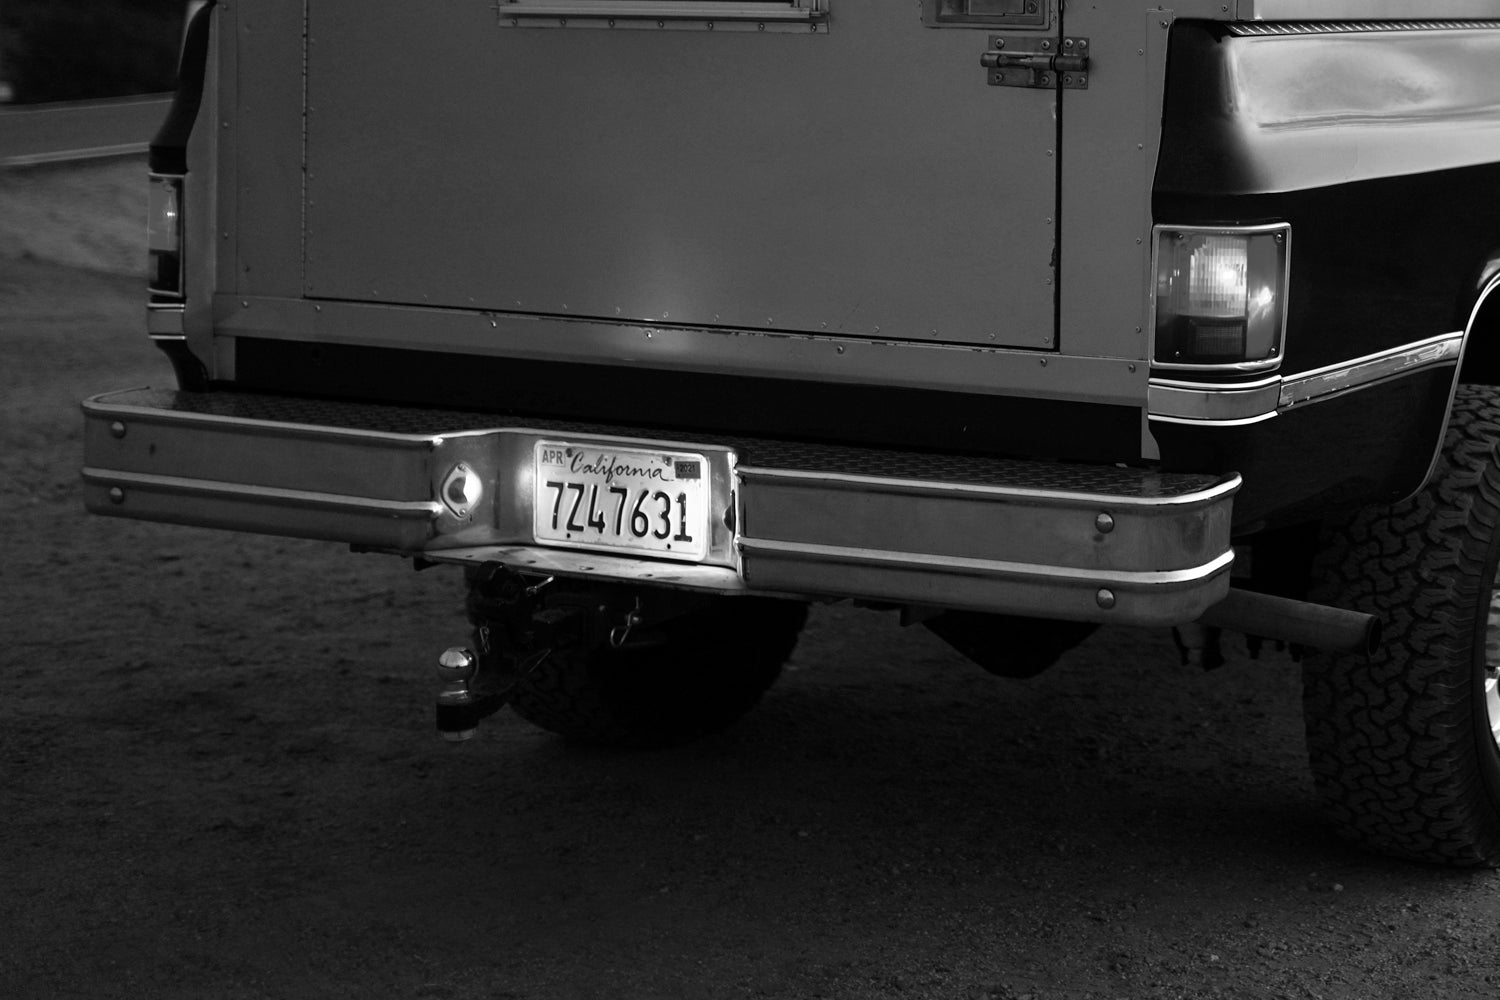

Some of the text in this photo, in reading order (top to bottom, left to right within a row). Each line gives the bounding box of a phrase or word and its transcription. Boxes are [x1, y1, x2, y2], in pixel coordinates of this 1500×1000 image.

[542, 450, 564, 465] APR
[570, 452, 674, 483] California
[546, 481, 693, 543] 7Z47631
